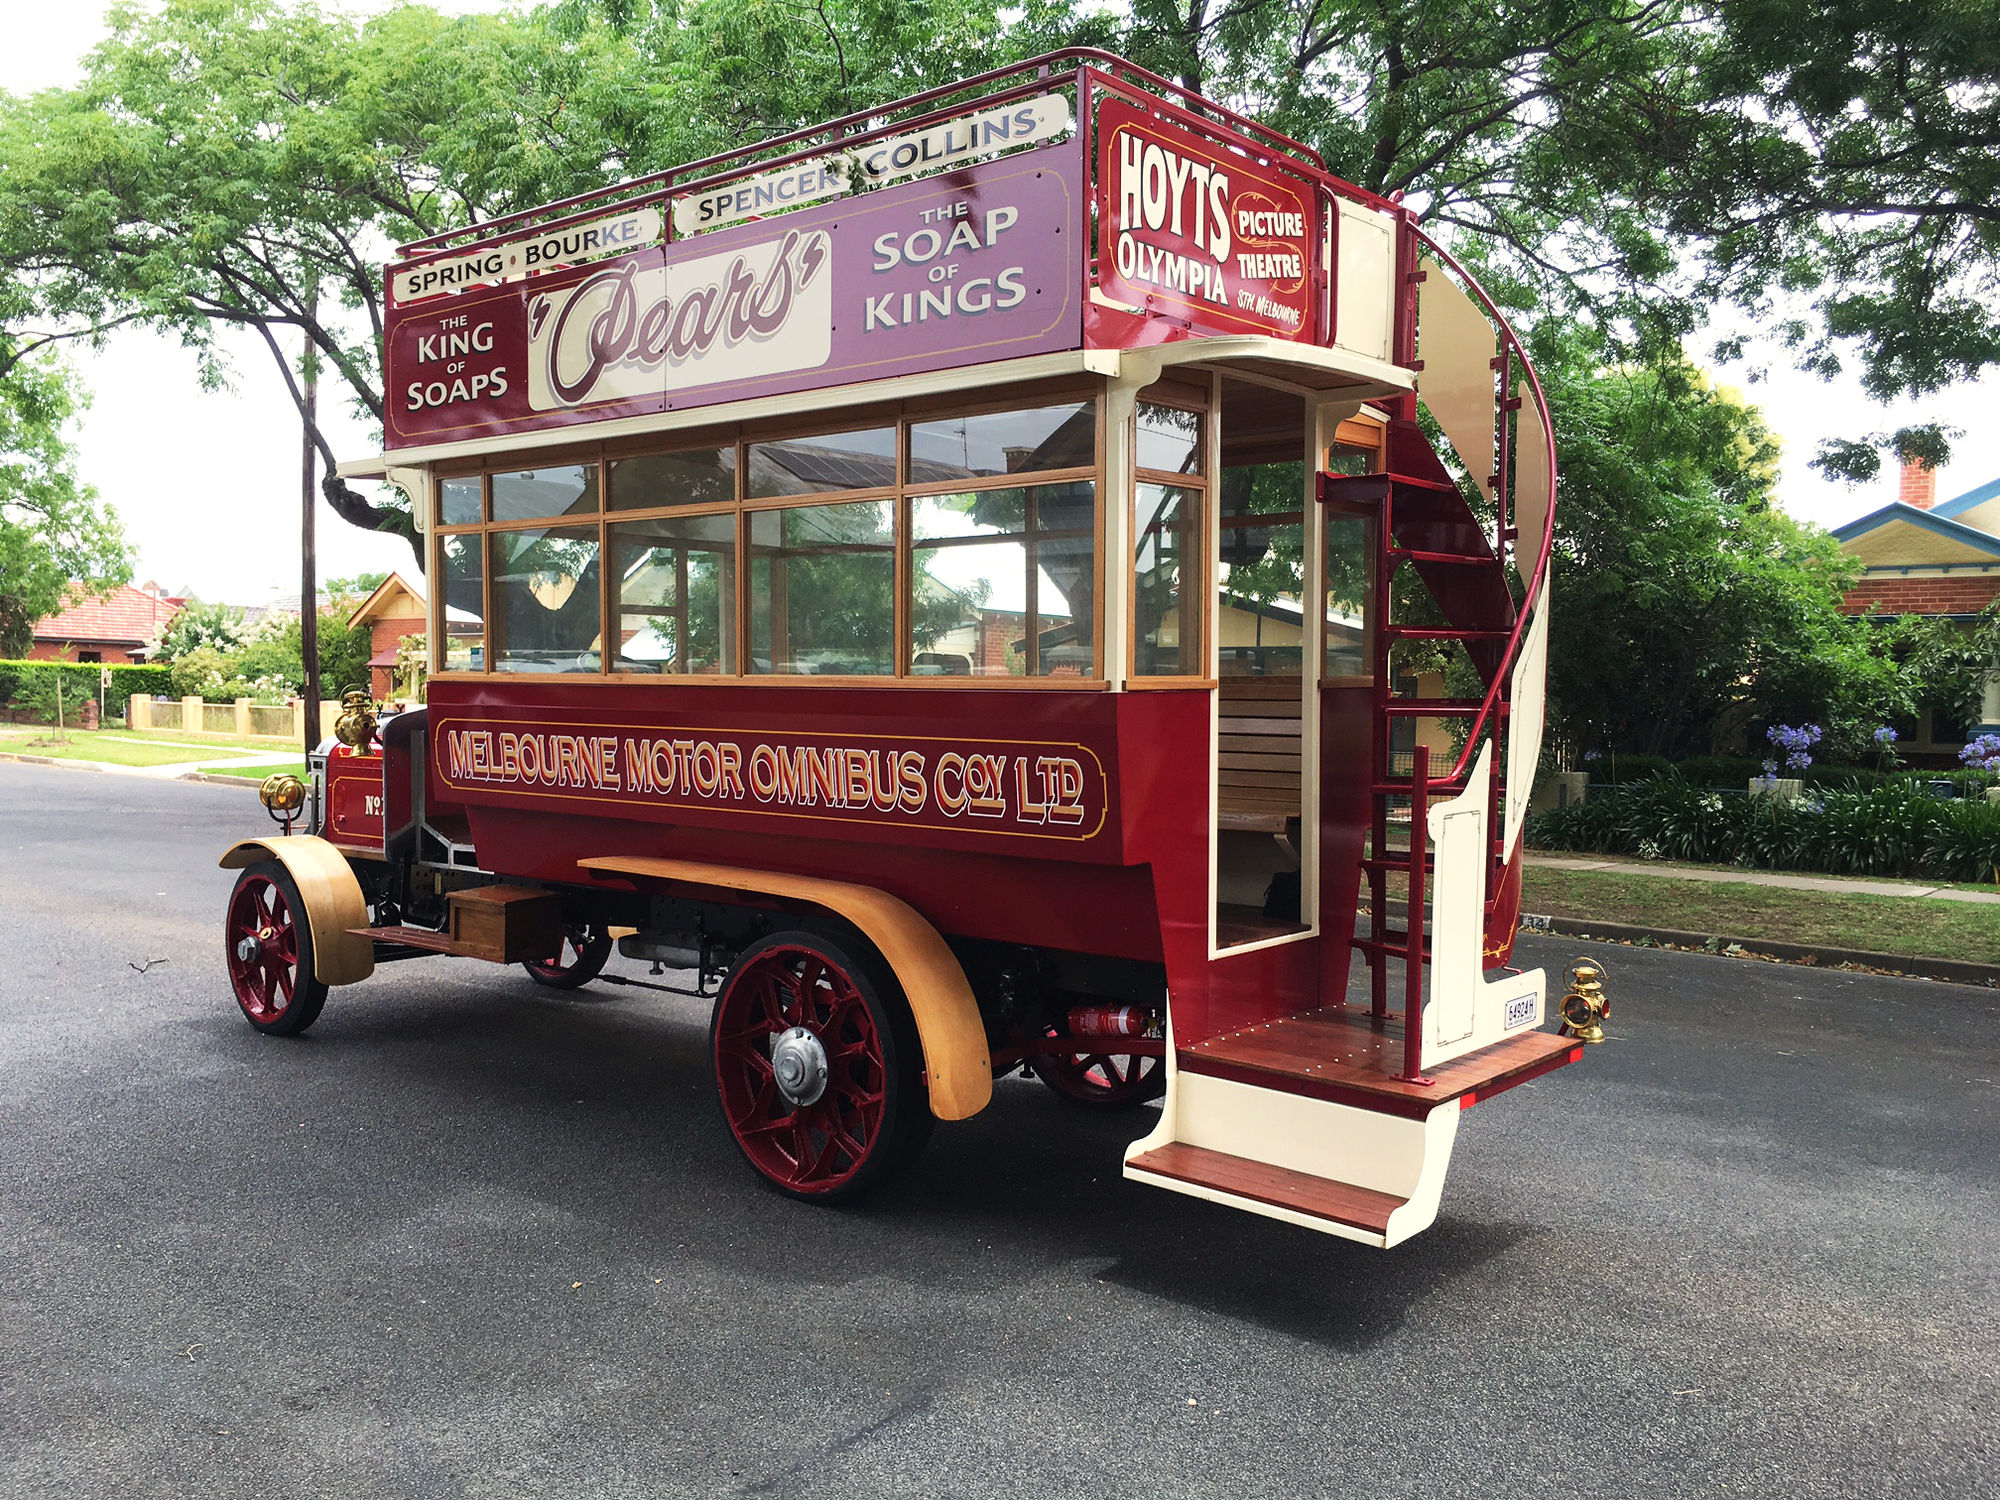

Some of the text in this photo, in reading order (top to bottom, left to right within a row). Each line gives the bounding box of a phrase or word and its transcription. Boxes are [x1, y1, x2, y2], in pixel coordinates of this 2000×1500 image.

[699, 108, 1037, 221] SPENCER COLLINS
[919, 201, 968, 225] THE
[1119, 130, 1231, 263] HOYT'S
[872, 206, 1019, 273] SOAP
[1238, 210, 1304, 237] PICTURE
[408, 218, 638, 294] SPRING BOURKE
[928, 264, 959, 283] OF
[1118, 231, 1229, 306] OLYMPIA
[1237, 253, 1302, 280] THEATRE
[864, 266, 1026, 332] KINGS
[1237, 289, 1300, 325] STH. MELBOURNE
[418, 322, 494, 363] KING
[440, 314, 467, 331] THE
[407, 366, 508, 413] SOAPS
[447, 361, 465, 375] OF
[448, 730, 621, 792] MELBOURNE
[624, 738, 745, 800] MOTOR
[749, 744, 927, 814] OMNIBUS
[1014, 756, 1084, 825] LTD
